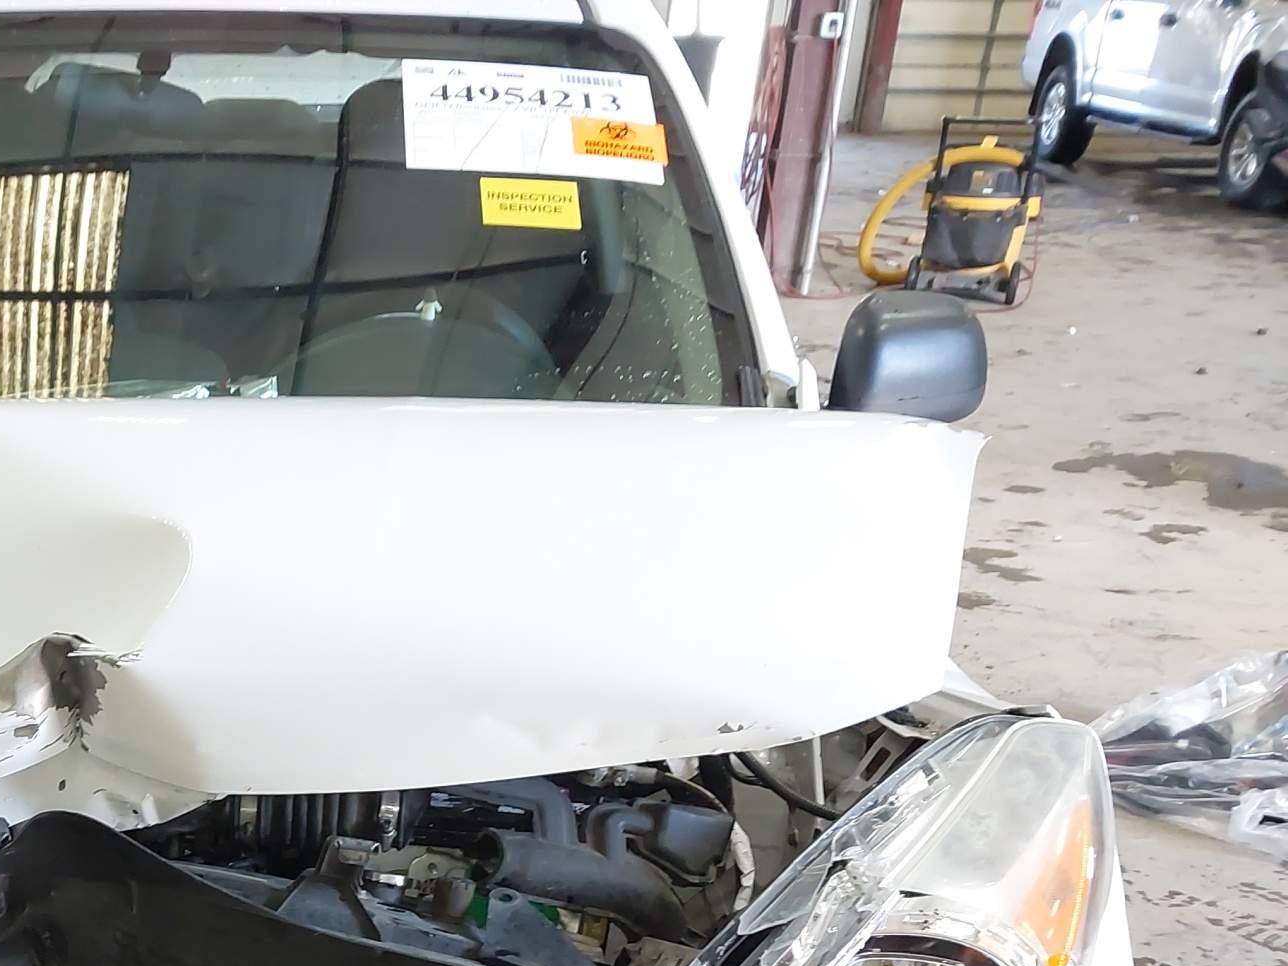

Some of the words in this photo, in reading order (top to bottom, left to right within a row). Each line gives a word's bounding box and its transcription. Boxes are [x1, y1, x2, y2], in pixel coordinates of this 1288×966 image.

[430, 84, 621, 111] 44954213
[585, 140, 654, 152] BIOHAZARD
[487, 190, 573, 203] INSPECTION
[499, 202, 563, 213] SERVICE
